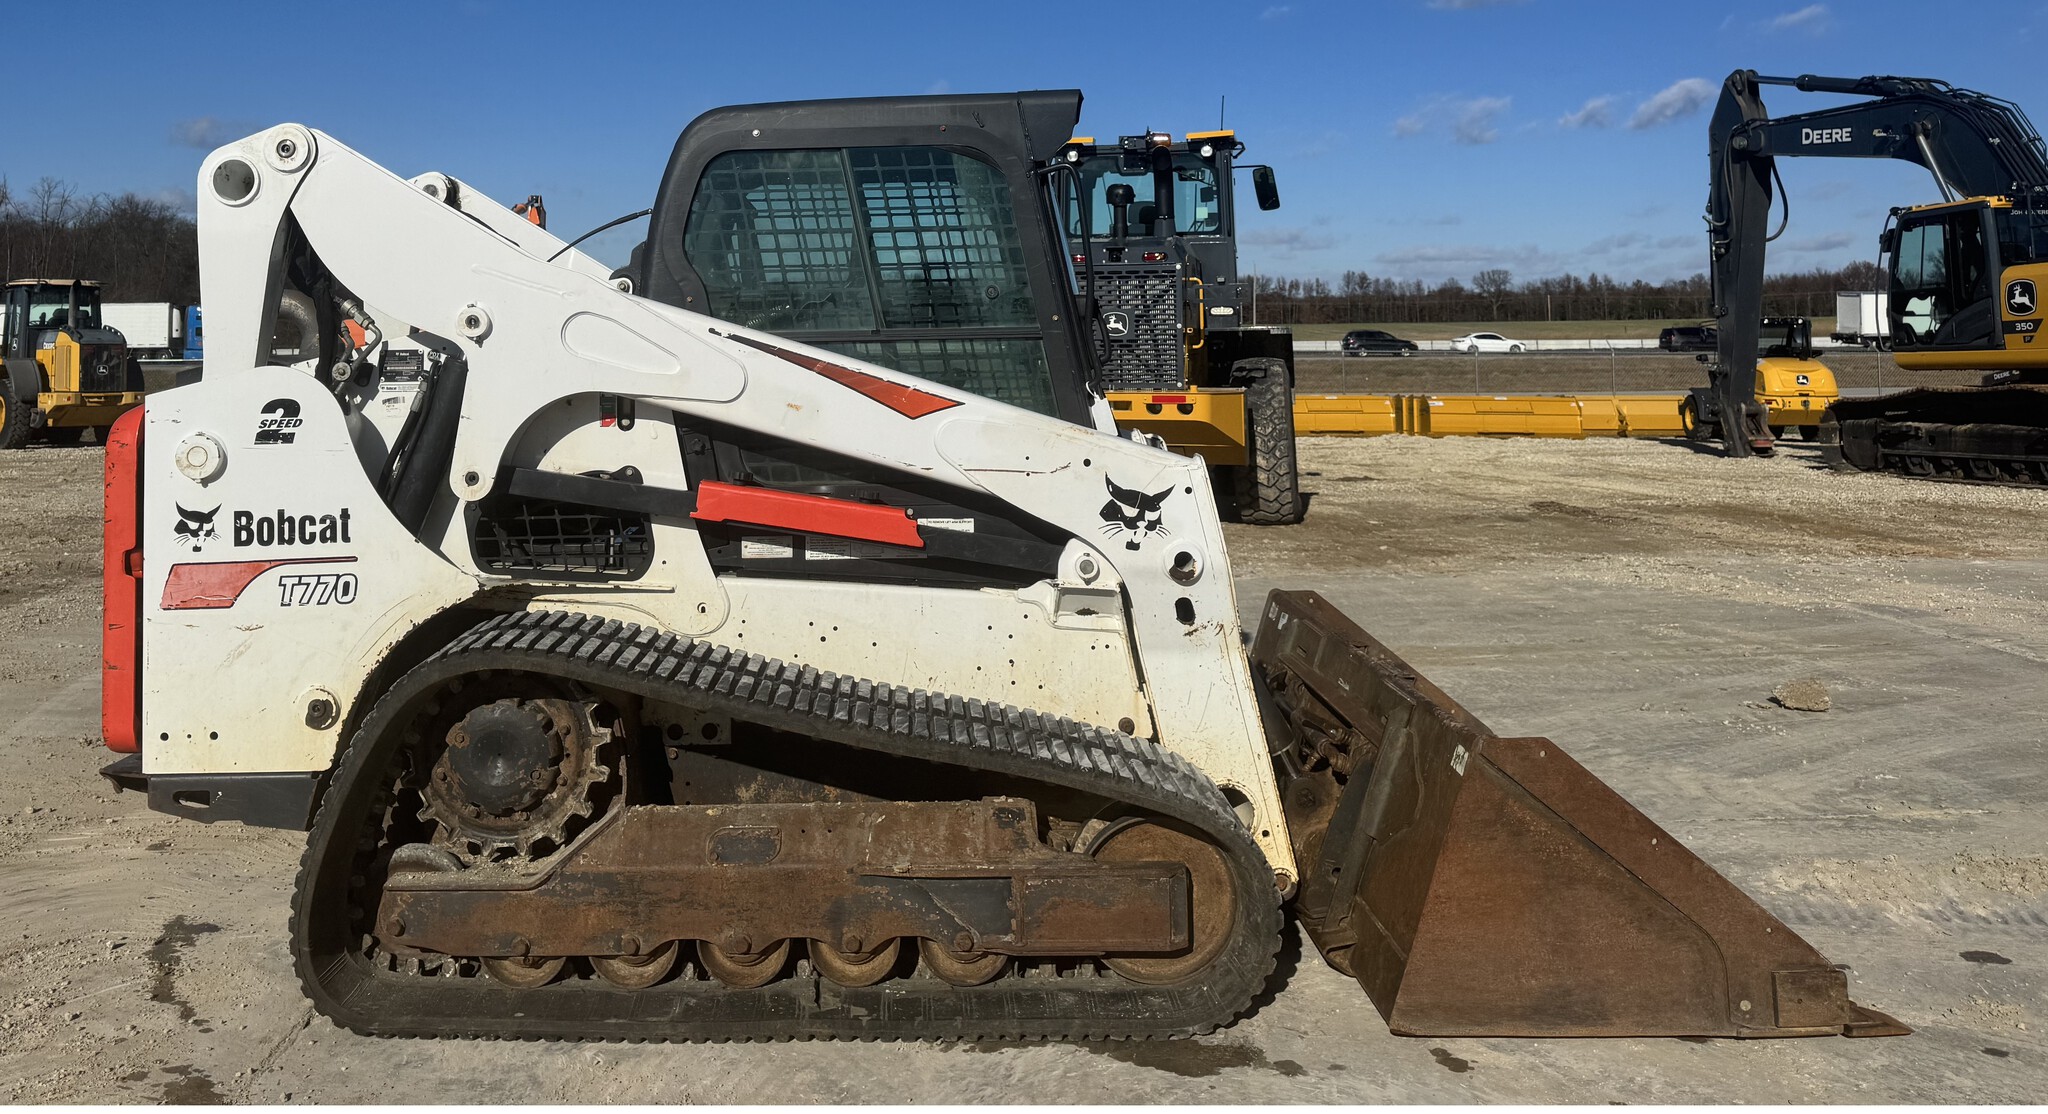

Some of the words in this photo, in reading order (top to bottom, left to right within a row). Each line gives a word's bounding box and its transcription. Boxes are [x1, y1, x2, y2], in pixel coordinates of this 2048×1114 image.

[1802, 128, 1852, 145] DEERE
[2015, 322, 2034, 331] 350
[253, 398, 301, 445] 2
[258, 418, 303, 429] SPEED
[233, 508, 352, 547] Bobcat
[278, 573, 359, 607] T770
